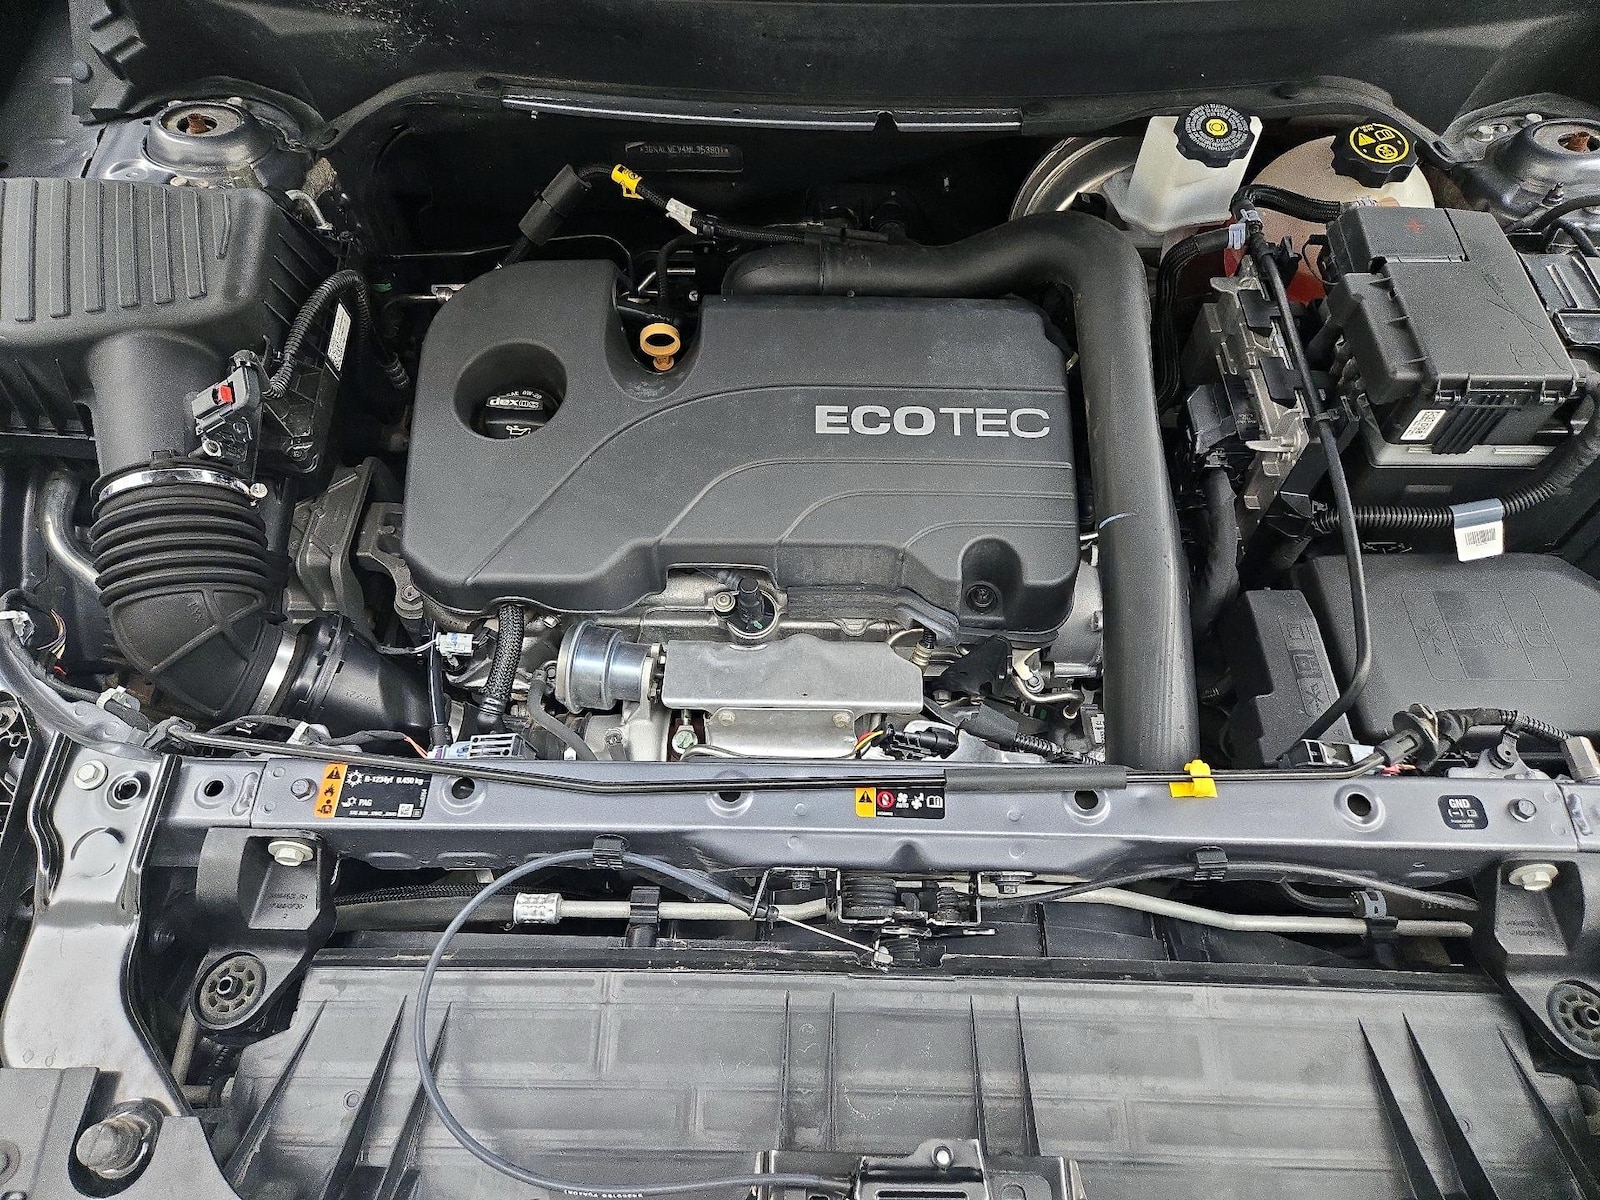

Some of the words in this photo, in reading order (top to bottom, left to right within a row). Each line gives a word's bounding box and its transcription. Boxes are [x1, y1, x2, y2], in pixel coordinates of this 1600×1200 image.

[815, 405, 1050, 438] ECOTEC
[358, 799, 373, 807] PAG
[1448, 798, 1471, 808] GND
